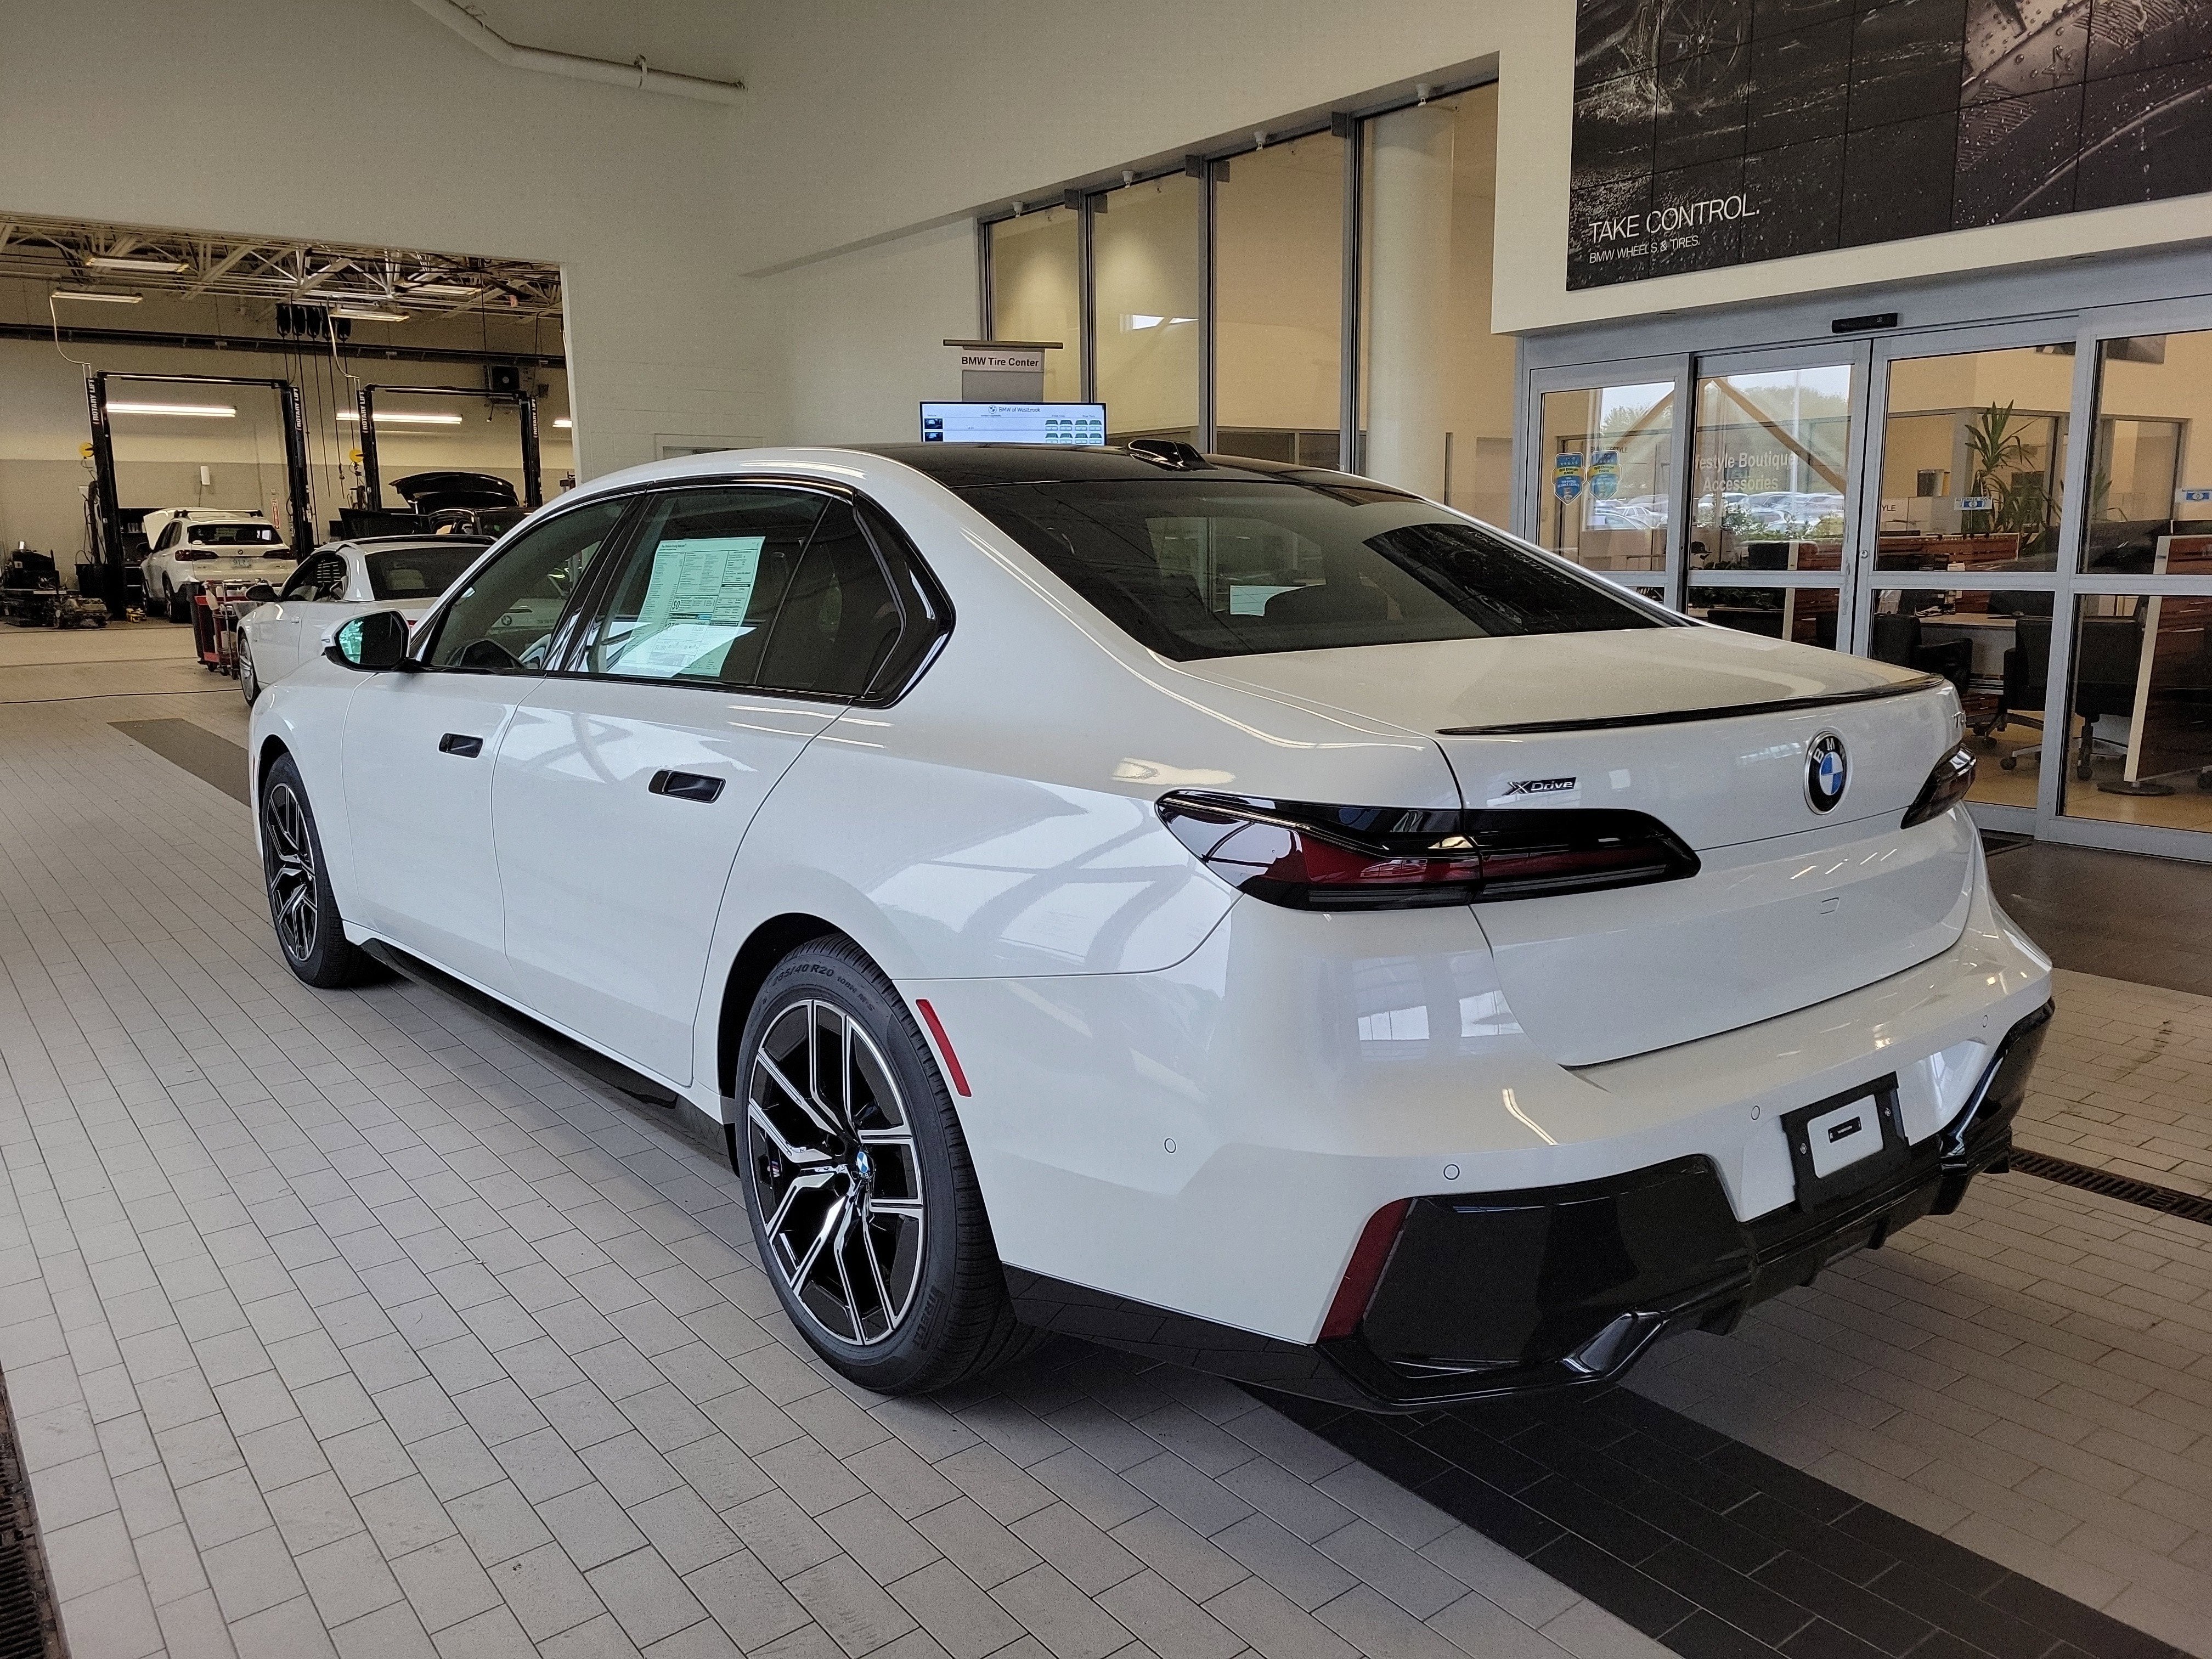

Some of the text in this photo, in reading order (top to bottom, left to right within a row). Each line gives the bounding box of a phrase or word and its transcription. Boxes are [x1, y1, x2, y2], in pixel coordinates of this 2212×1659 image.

[1589, 193, 1760, 244] TAKE CONTROL.
[1589, 249, 1615, 264] BMW
[1617, 242, 1658, 260] WHEELS
[1660, 241, 1668, 252] &
[962, 357, 1039, 366] BMW Tire Center
[90, 394, 99, 421] ROTARY
[1739, 451, 1795, 470] Boutique
[1703, 475, 1778, 492] Accessories
[1813, 738, 1846, 764] BMW
[811, 964, 834, 977] R20
